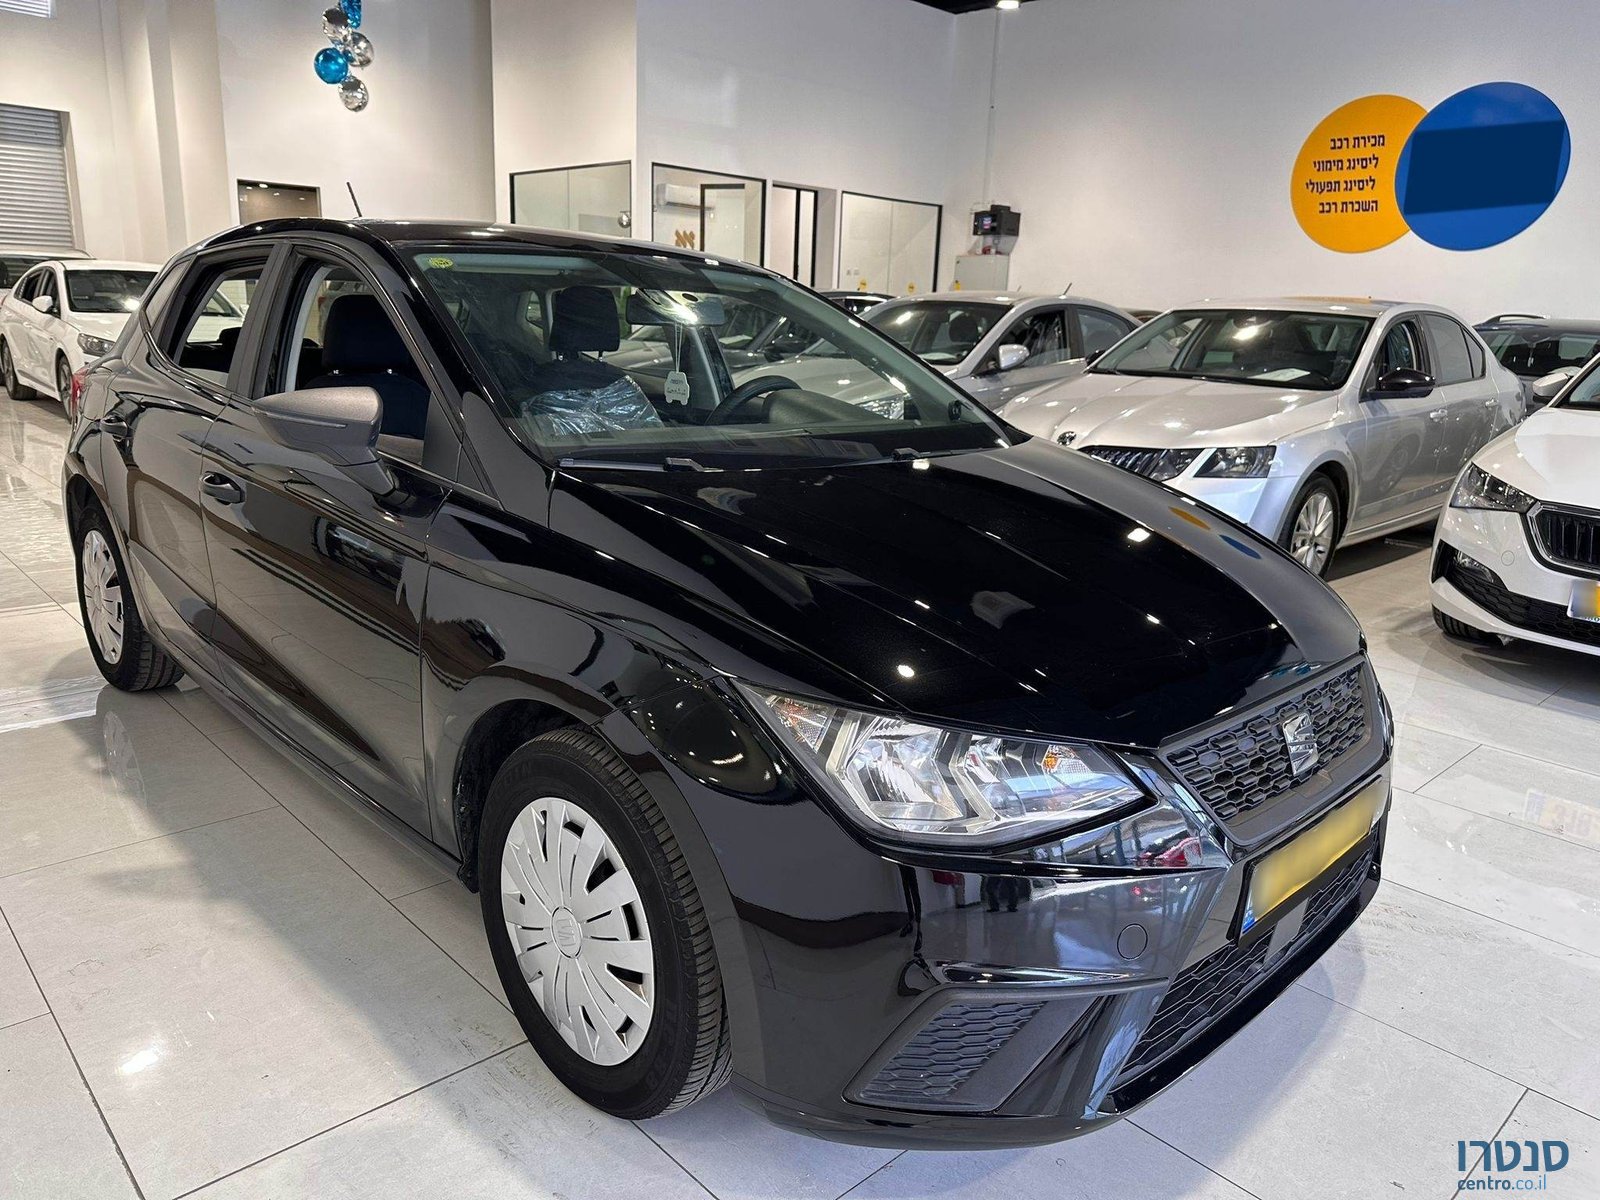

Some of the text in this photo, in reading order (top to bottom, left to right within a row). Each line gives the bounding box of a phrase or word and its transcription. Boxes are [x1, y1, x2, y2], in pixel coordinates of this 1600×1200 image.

[1330, 134, 1386, 151] מכירת רכב
[1313, 153, 1379, 172] ליסינג מימוני
[1305, 175, 1376, 194] ליסינג תפעולי
[1318, 200, 1379, 214] השכרת רכב
